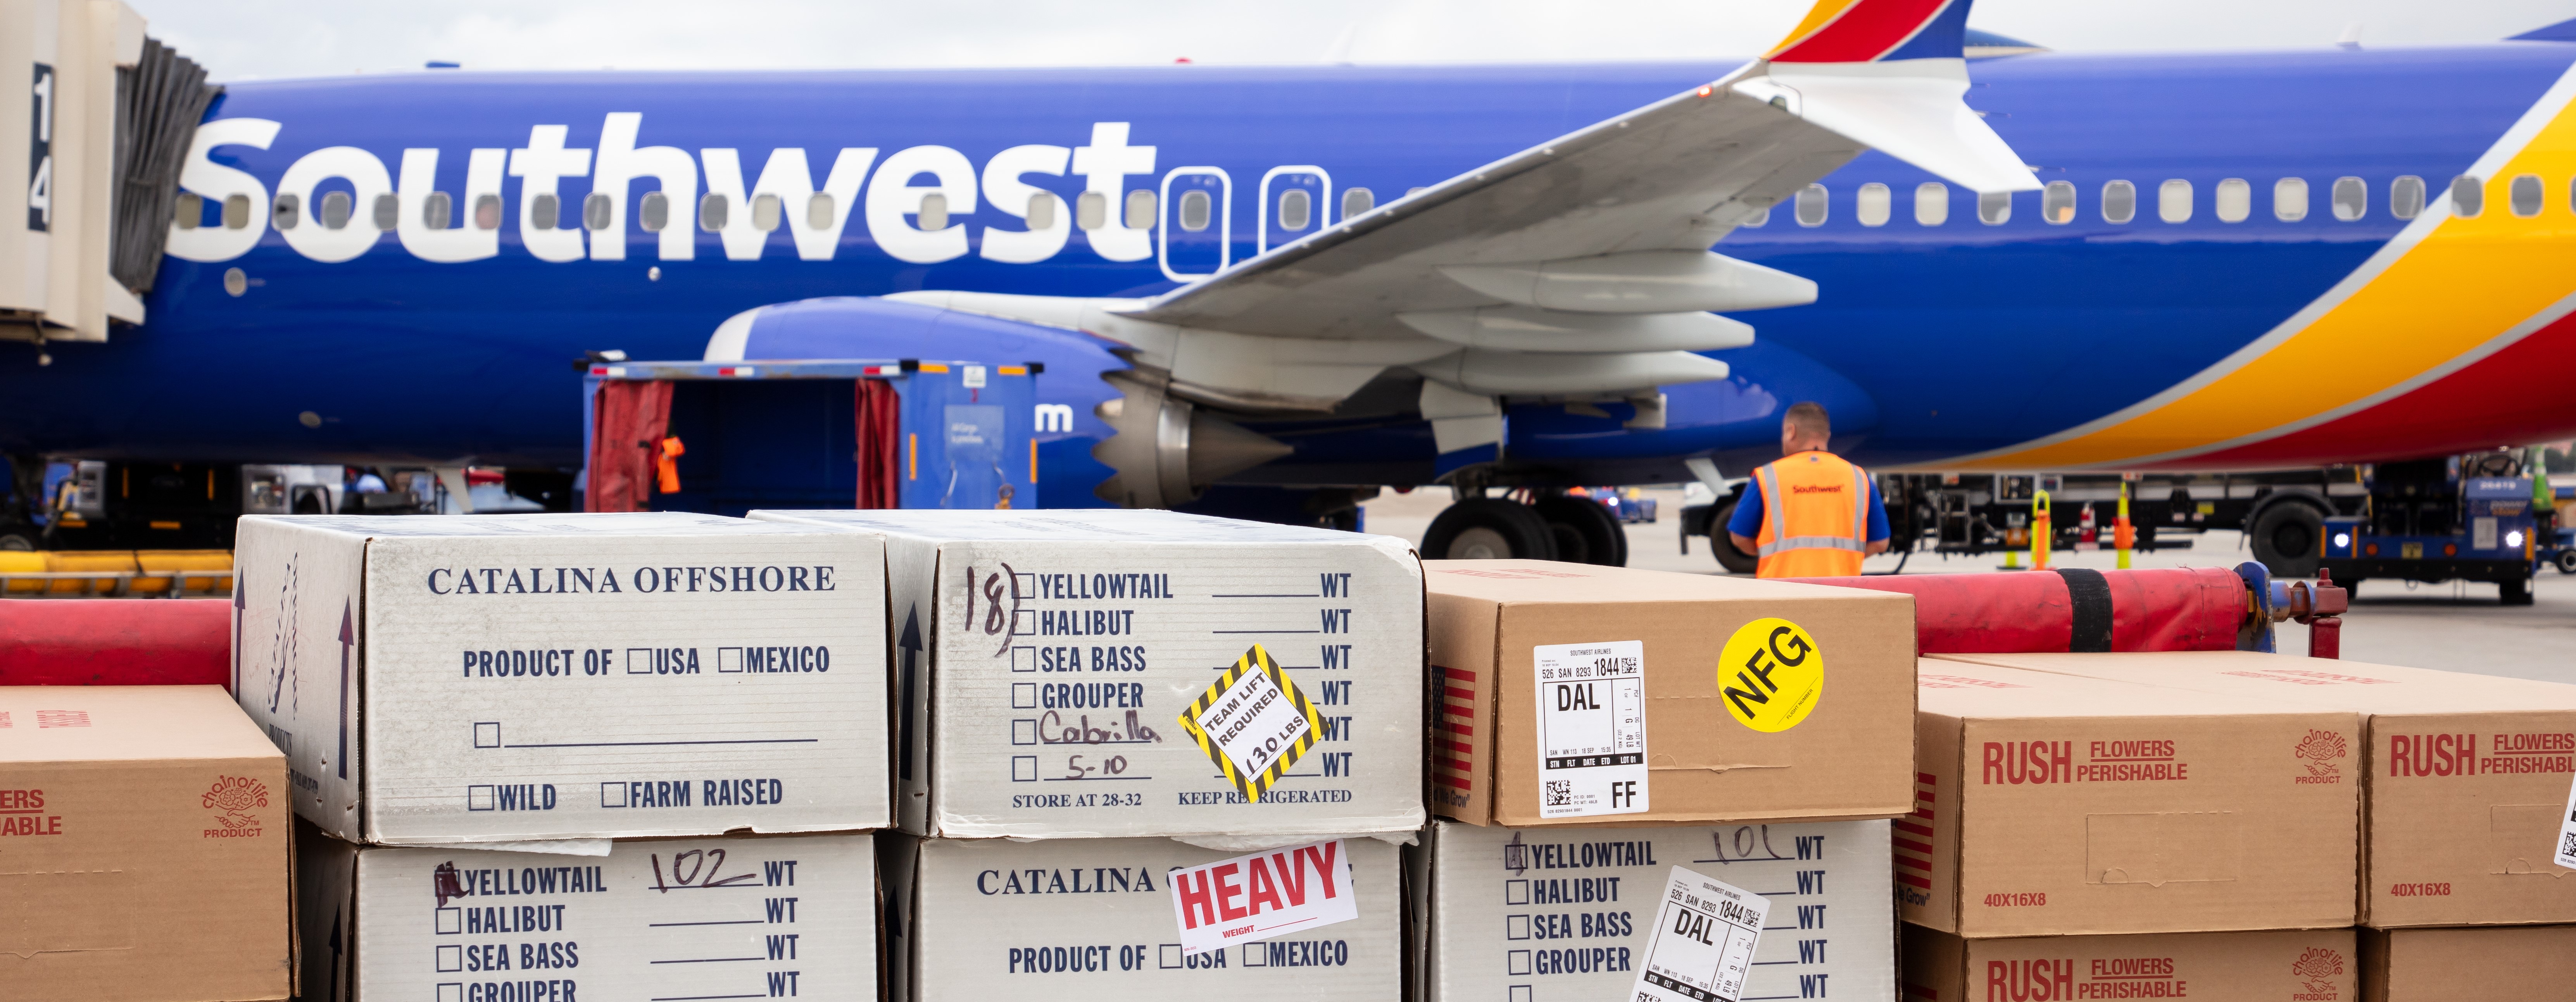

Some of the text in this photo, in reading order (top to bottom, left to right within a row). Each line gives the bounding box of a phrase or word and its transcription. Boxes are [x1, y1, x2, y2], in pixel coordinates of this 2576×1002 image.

[163, 112, 1156, 263] Southwest
[1793, 484, 1842, 494] Southwest
[428, 566, 836, 595] CATALINA OFFSHORE
[1039, 573, 1351, 599] YELLOWTAIL WT
[1041, 609, 1351, 636] HALIBUT WT
[463, 645, 830, 678] PRODUCT OF USA MEXICO
[1041, 645, 1352, 672] SEA BASS WT
[1542, 657, 1619, 679] 526 SAN 8293 1844
[1723, 626, 1812, 720] NFG
[1042, 681, 1352, 709] GROUPER WT
[1204, 672, 1265, 731] TEAM LIFT
[1558, 683, 1600, 711] DAL
[1786, 688, 1813, 720] FLIGHT NUMBER
[1039, 710, 1162, 744] Cabrilla
[1218, 688, 1278, 746] REQUIRED
[1278, 716, 1304, 742] LBS
[1323, 716, 1352, 741] WT
[1065, 755, 1127, 780] 5-10
[1322, 752, 1353, 777] WT
[1983, 740, 2175, 785] RUSH FLOWERS
[2390, 733, 2575, 777] RUSH FLOWERS
[2481, 757, 2576, 774] PERISHABL
[2077, 763, 2188, 782] PERISHABLE
[2295, 776, 2341, 784] PRODUCT
[498, 778, 783, 811] WILD FARM RAISED
[1012, 793, 1142, 808] STORE AT 28-32
[1178, 789, 1352, 805] KEEP RERIGERATED
[1612, 781, 1636, 809] FF
[0, 816, 62, 836] ABLE
[204, 828, 262, 838] PRODUCT
[1531, 836, 1825, 869] YELLOWTAIL WT
[465, 861, 797, 896] YELLOWTAIL WT
[651, 849, 757, 893] 102
[977, 867, 1156, 895] CATALINA
[1176, 841, 1337, 930] HEAVY
[1534, 870, 1825, 904] HALIBUT WT
[1703, 882, 1741, 900] SOUTHWEST AIRLINES
[1984, 892, 2046, 907] 40X16X8
[2391, 882, 2451, 897] 40X16X8
[467, 897, 798, 934] HALIBUT WT
[1671, 889, 1744, 923] 526 SAN 8293 1844
[1222, 924, 1254, 938] WEIGHT
[1534, 905, 1827, 940] SEA BASS WT
[1674, 909, 1713, 946] DAL
[467, 934, 799, 972] SEA BASS WT
[1009, 945, 1111, 973] PRODUCT
[1120, 945, 1146, 971] OF
[1270, 940, 1348, 967] MEXICO
[1536, 939, 1827, 975] GROUPER WT
[468, 979, 576, 1002] GROUPER
[767, 971, 800, 997] WT
[1649, 974, 1704, 1000] STN FLT DATE ETD
[1800, 974, 1829, 999] WT
[1988, 957, 2174, 1002] RUSH FLOWERS
[2079, 981, 2187, 1000] PERISHABLE
[2293, 993, 2338, 1001] PRODUCT
